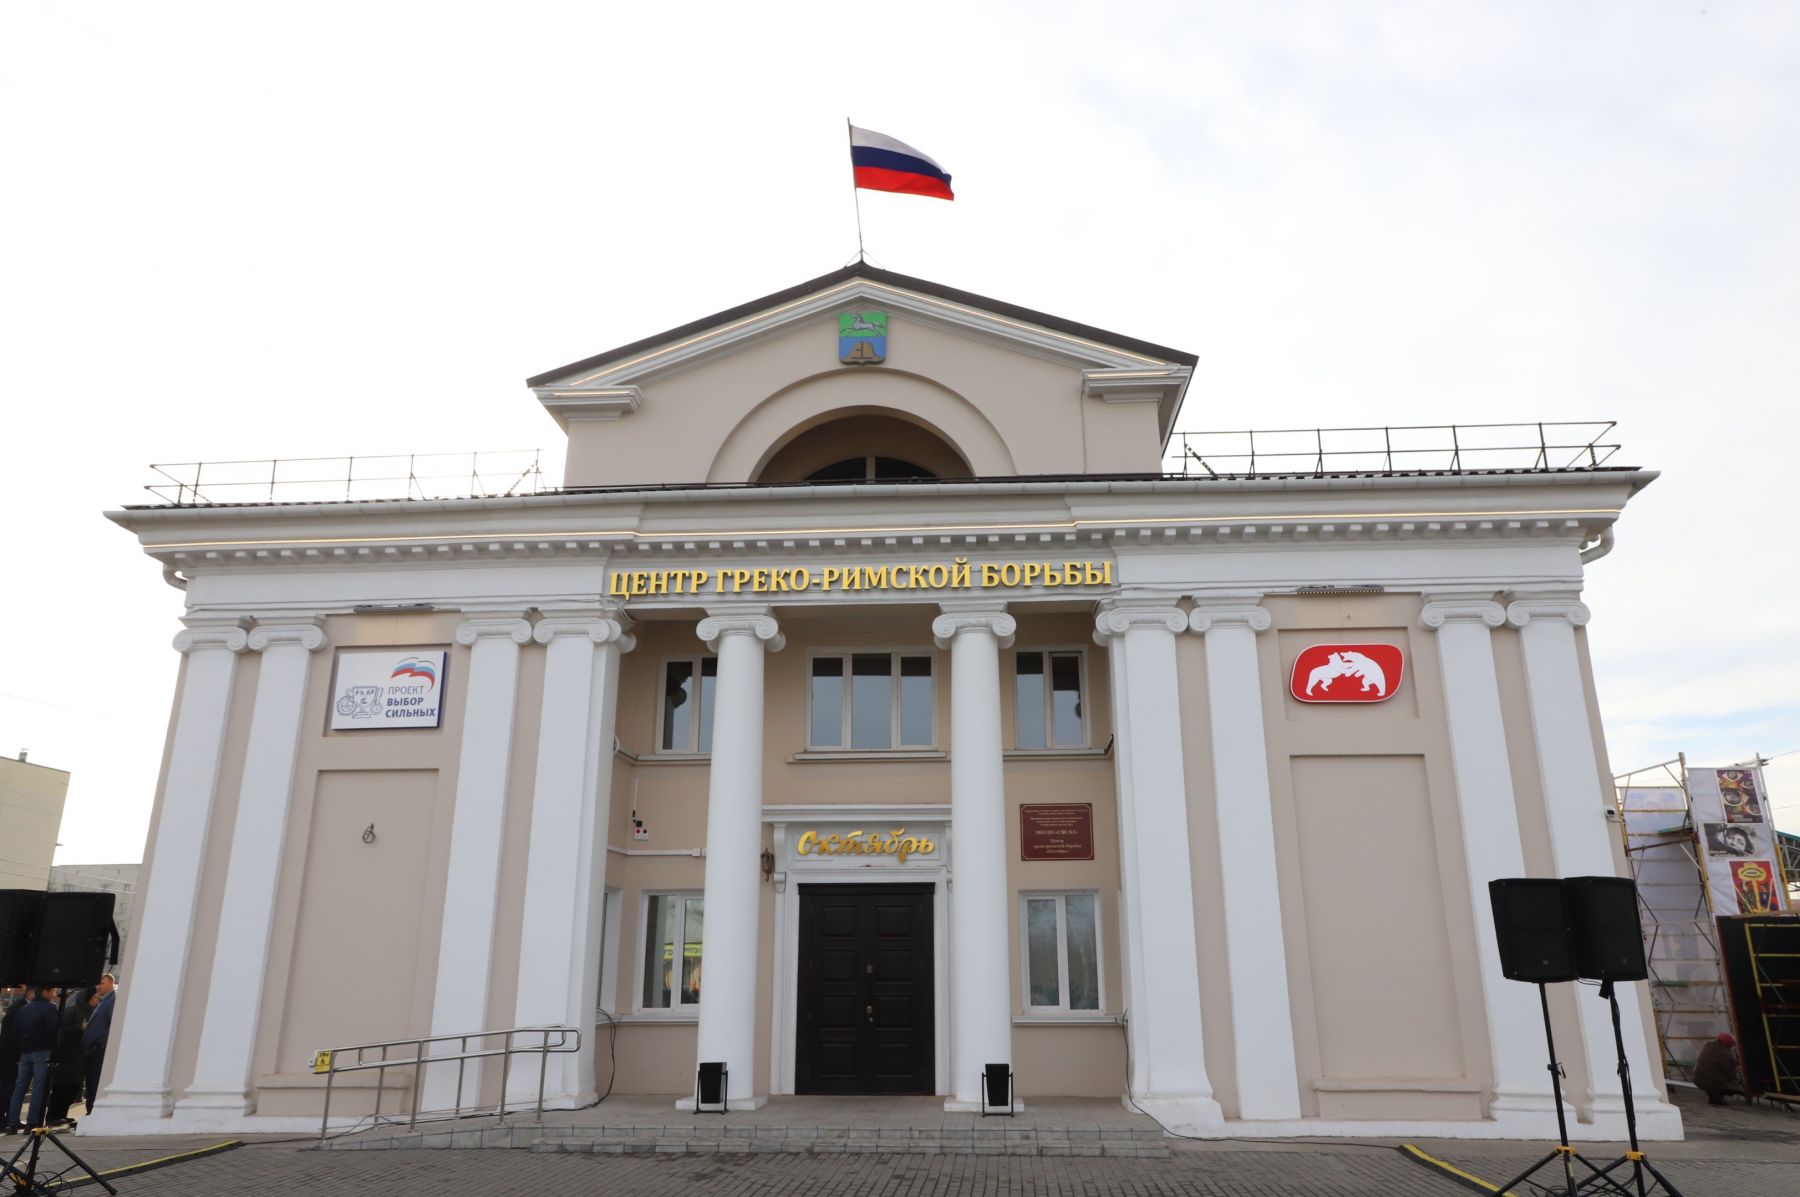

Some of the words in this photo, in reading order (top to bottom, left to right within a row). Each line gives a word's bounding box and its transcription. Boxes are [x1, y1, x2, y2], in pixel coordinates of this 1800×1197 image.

[609, 570, 708, 600] ЦЕНТР
[716, 557, 972, 593] ГРЕКО-РИМСКОЙ
[981, 560, 1113, 587] БОРЬБЫ
[388, 686, 424, 695] ПРОЕКТ
[387, 698, 424, 706] ВЫБОР
[385, 708, 436, 718] СИЛЬНЫХ
[797, 828, 935, 864] Октябрь
